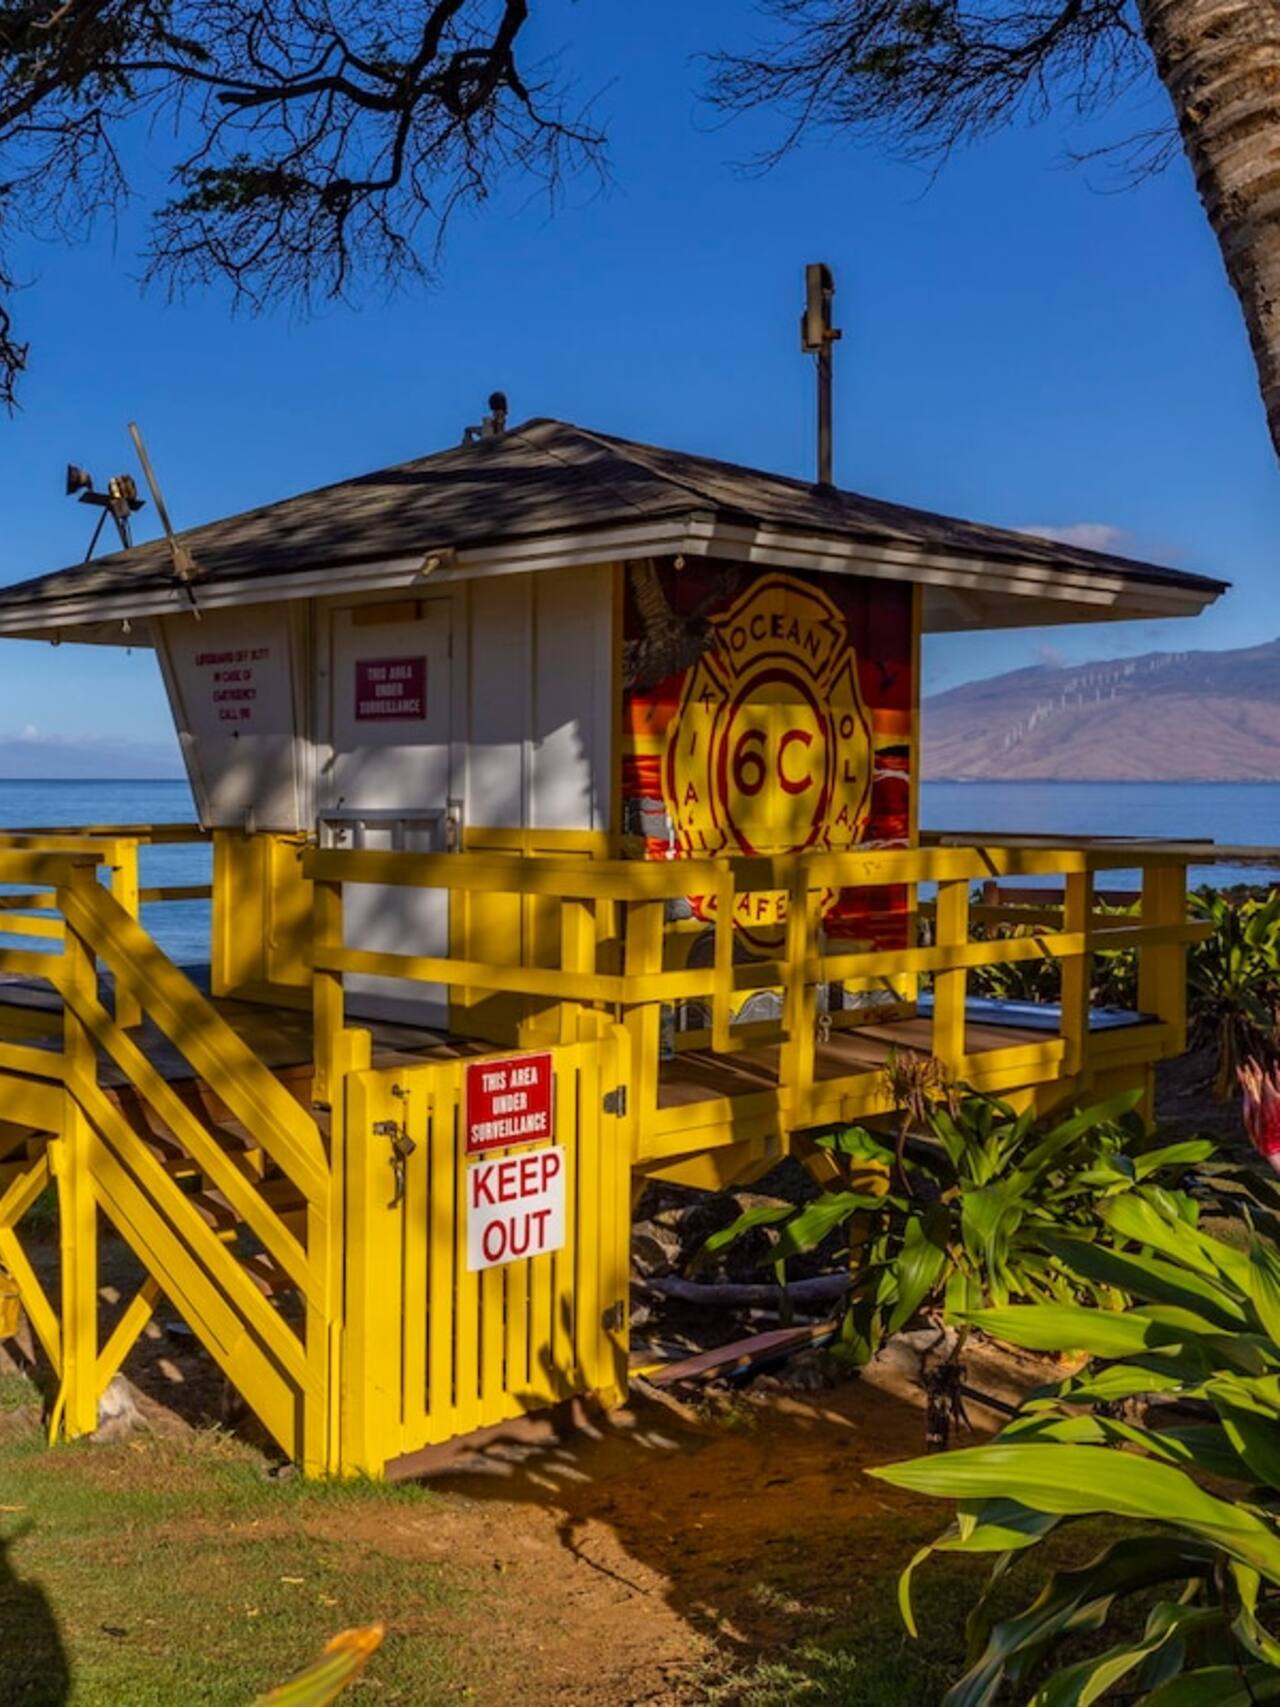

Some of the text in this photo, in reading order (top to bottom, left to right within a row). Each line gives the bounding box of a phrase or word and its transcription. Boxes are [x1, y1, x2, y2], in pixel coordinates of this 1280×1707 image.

[729, 613, 819, 660] OCEAN
[223, 670, 241, 682] CASE
[367, 663, 413, 681] THIS AREA
[375, 682, 403, 697] UNDER
[359, 698, 421, 715] SURVEILLANCE
[732, 728, 813, 797] 6C
[481, 1066, 539, 1093] THIS AREA
[492, 1092, 528, 1116] UNDER
[470, 1111, 548, 1144] SURVEILLANCE
[472, 1152, 560, 1209] KEEP
[482, 1208, 552, 1262] OUT
